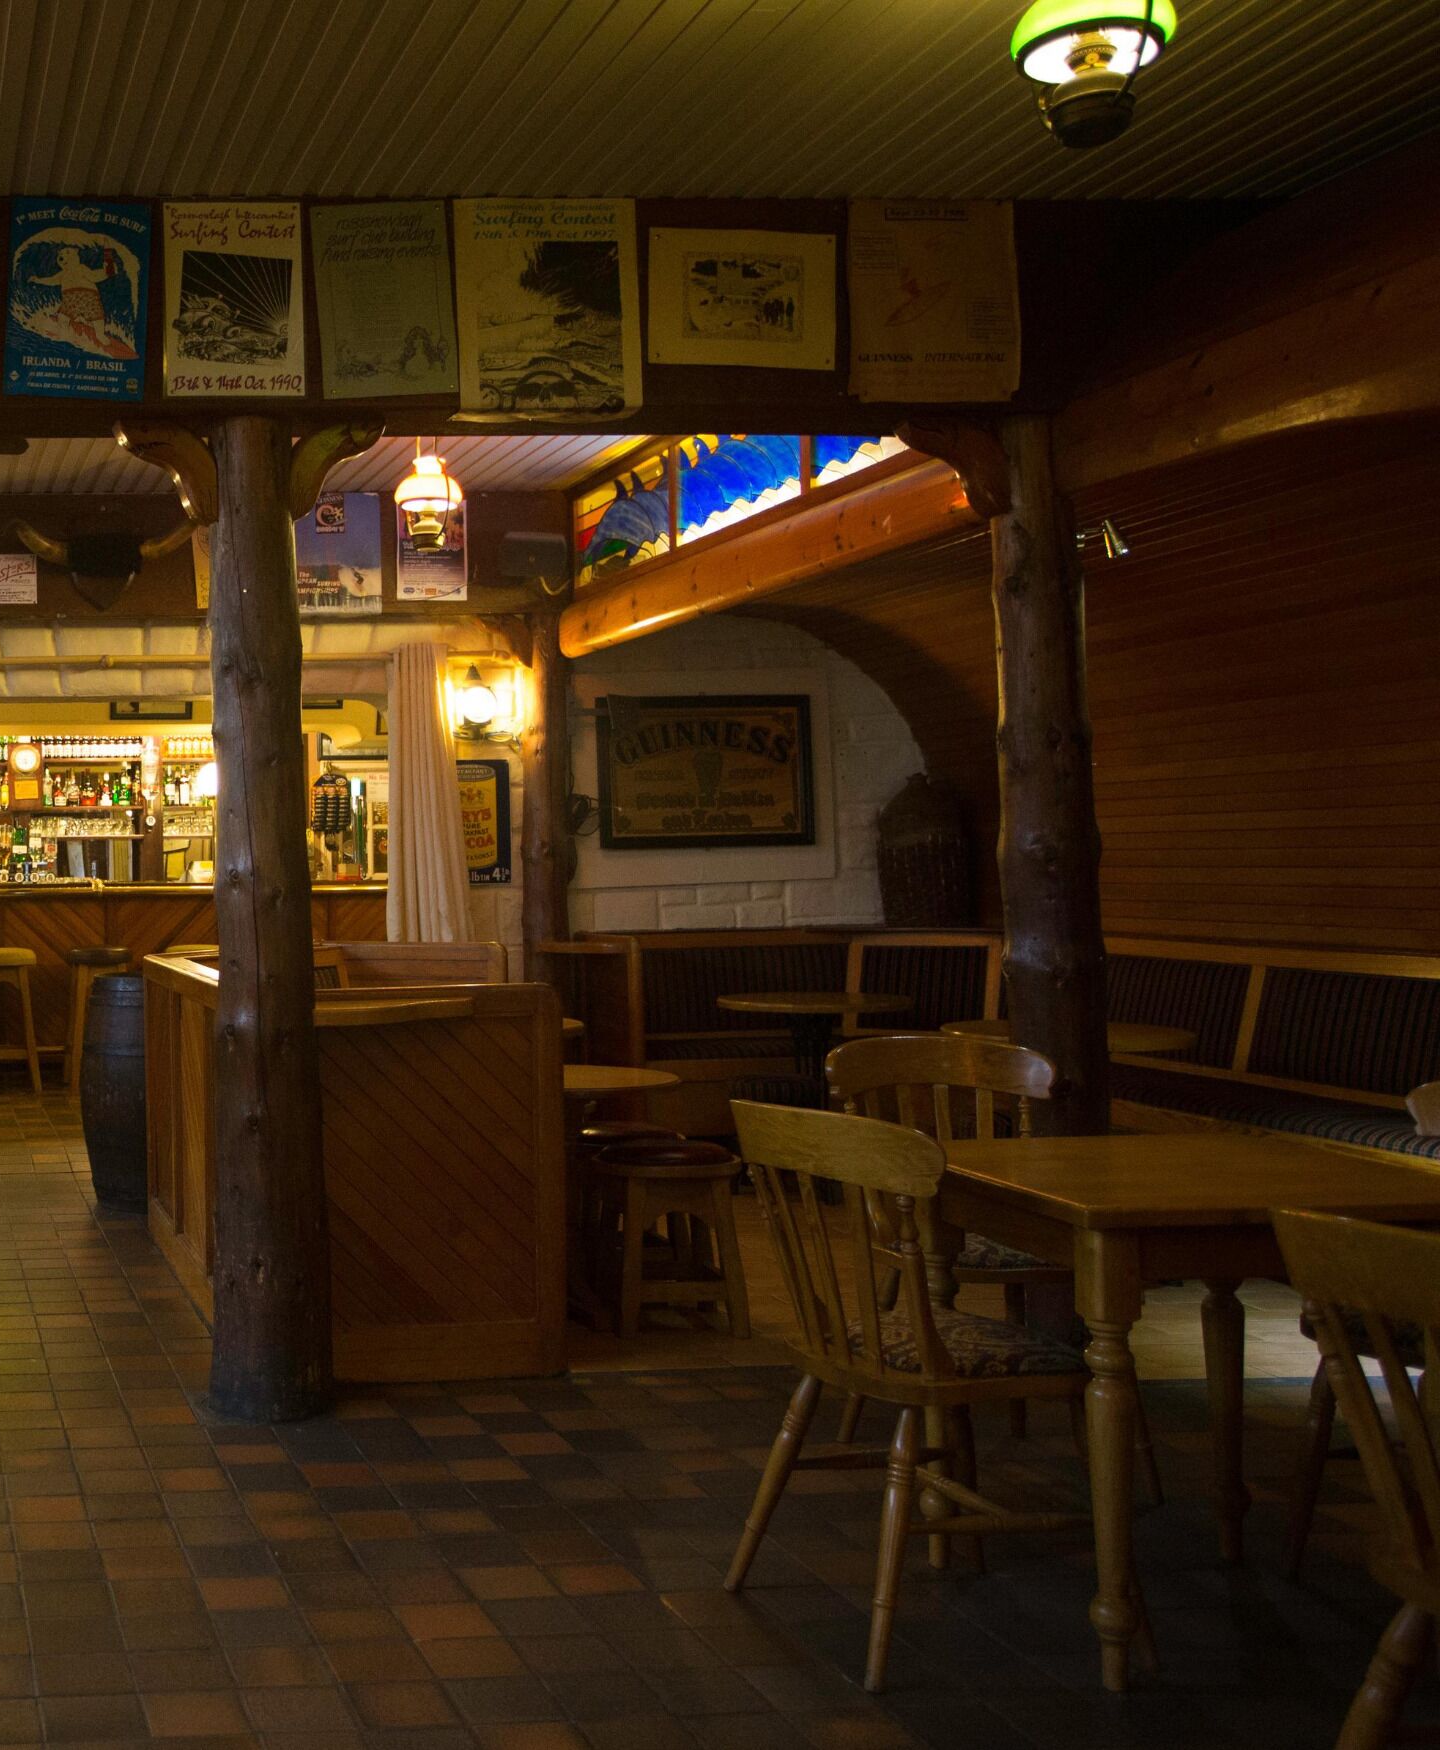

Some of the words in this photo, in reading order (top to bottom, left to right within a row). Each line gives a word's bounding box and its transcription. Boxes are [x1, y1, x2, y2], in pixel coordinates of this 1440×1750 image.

[28, 209, 57, 221] MEET
[104, 212, 119, 224] DE
[120, 216, 147, 234] SURF
[472, 210, 544, 228] Surfing
[549, 211, 616, 226] Contest
[171, 221, 228, 245] Surfing
[239, 220, 295, 239] Contest
[388, 227, 436, 246] building
[22, 355, 71, 368] IRLANDA
[86, 361, 127, 372] BRASIL
[611, 718, 791, 767] GUINNESS
